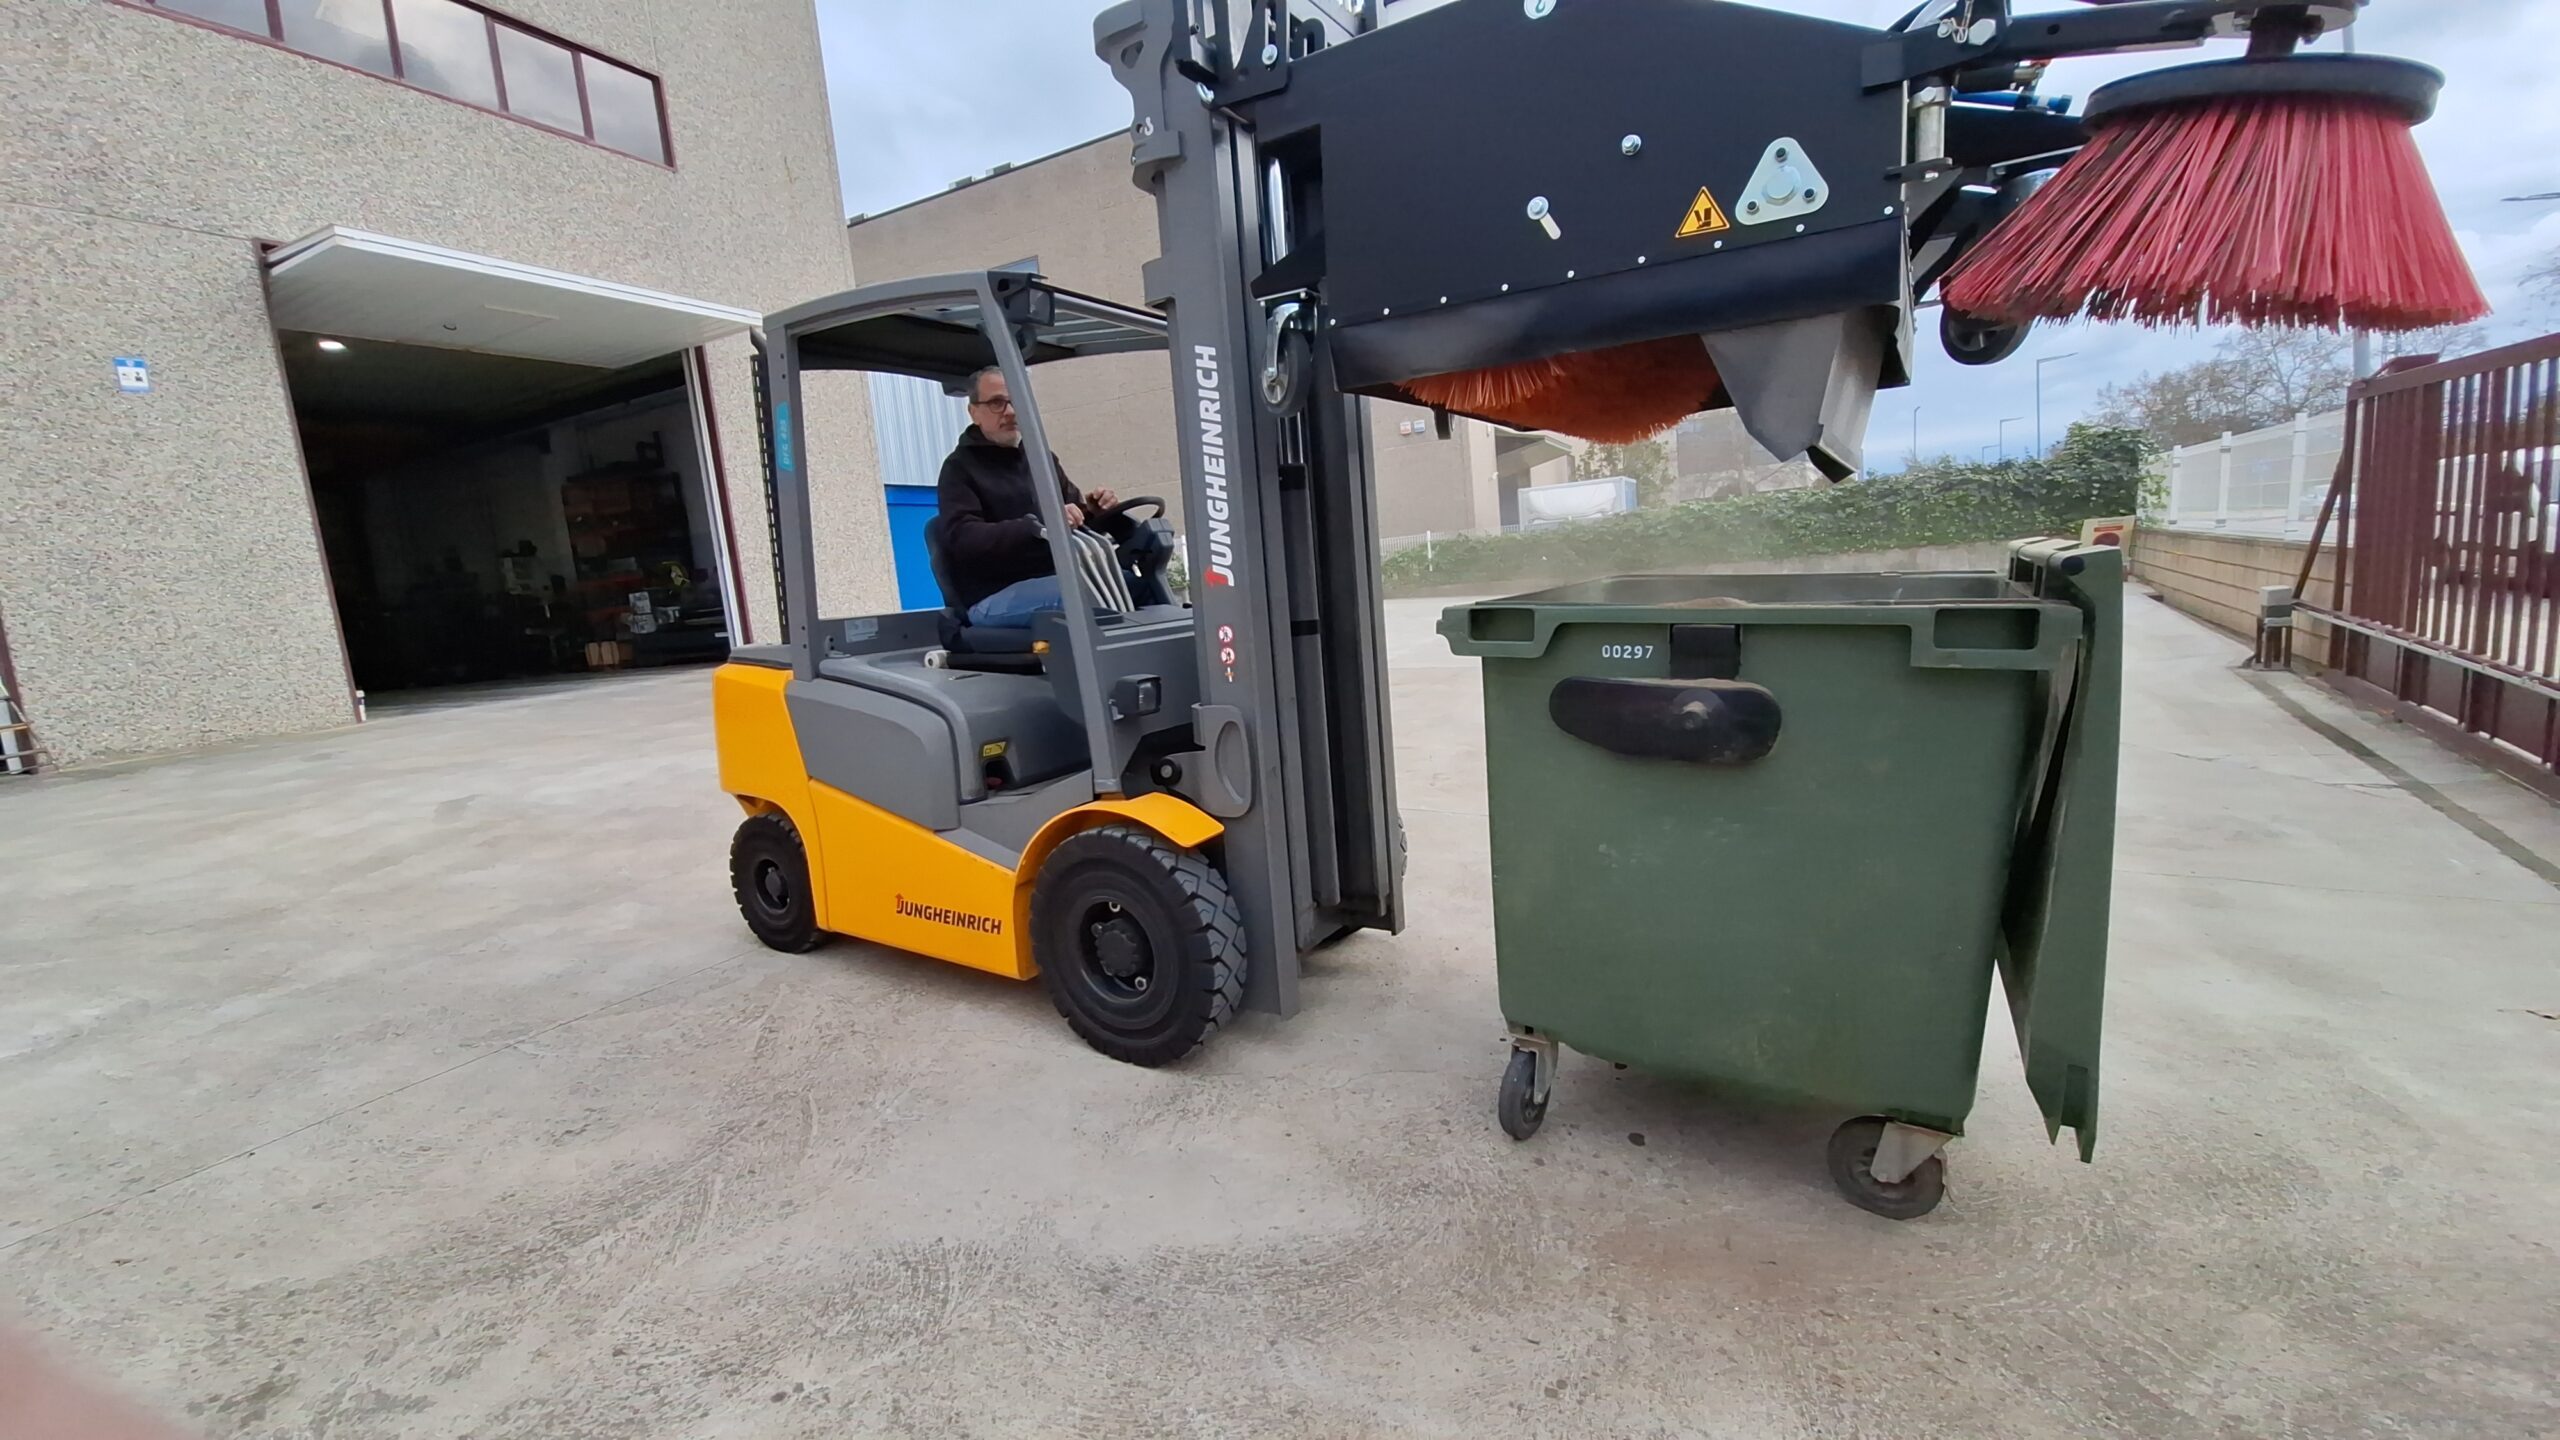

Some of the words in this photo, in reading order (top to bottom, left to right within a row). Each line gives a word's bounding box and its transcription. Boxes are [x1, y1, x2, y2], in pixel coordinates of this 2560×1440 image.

[1195, 345, 1235, 587] JUNGHEINRICH
[1601, 644, 1654, 659] 00297
[895, 898, 1002, 935] JUNGHEINRICH
